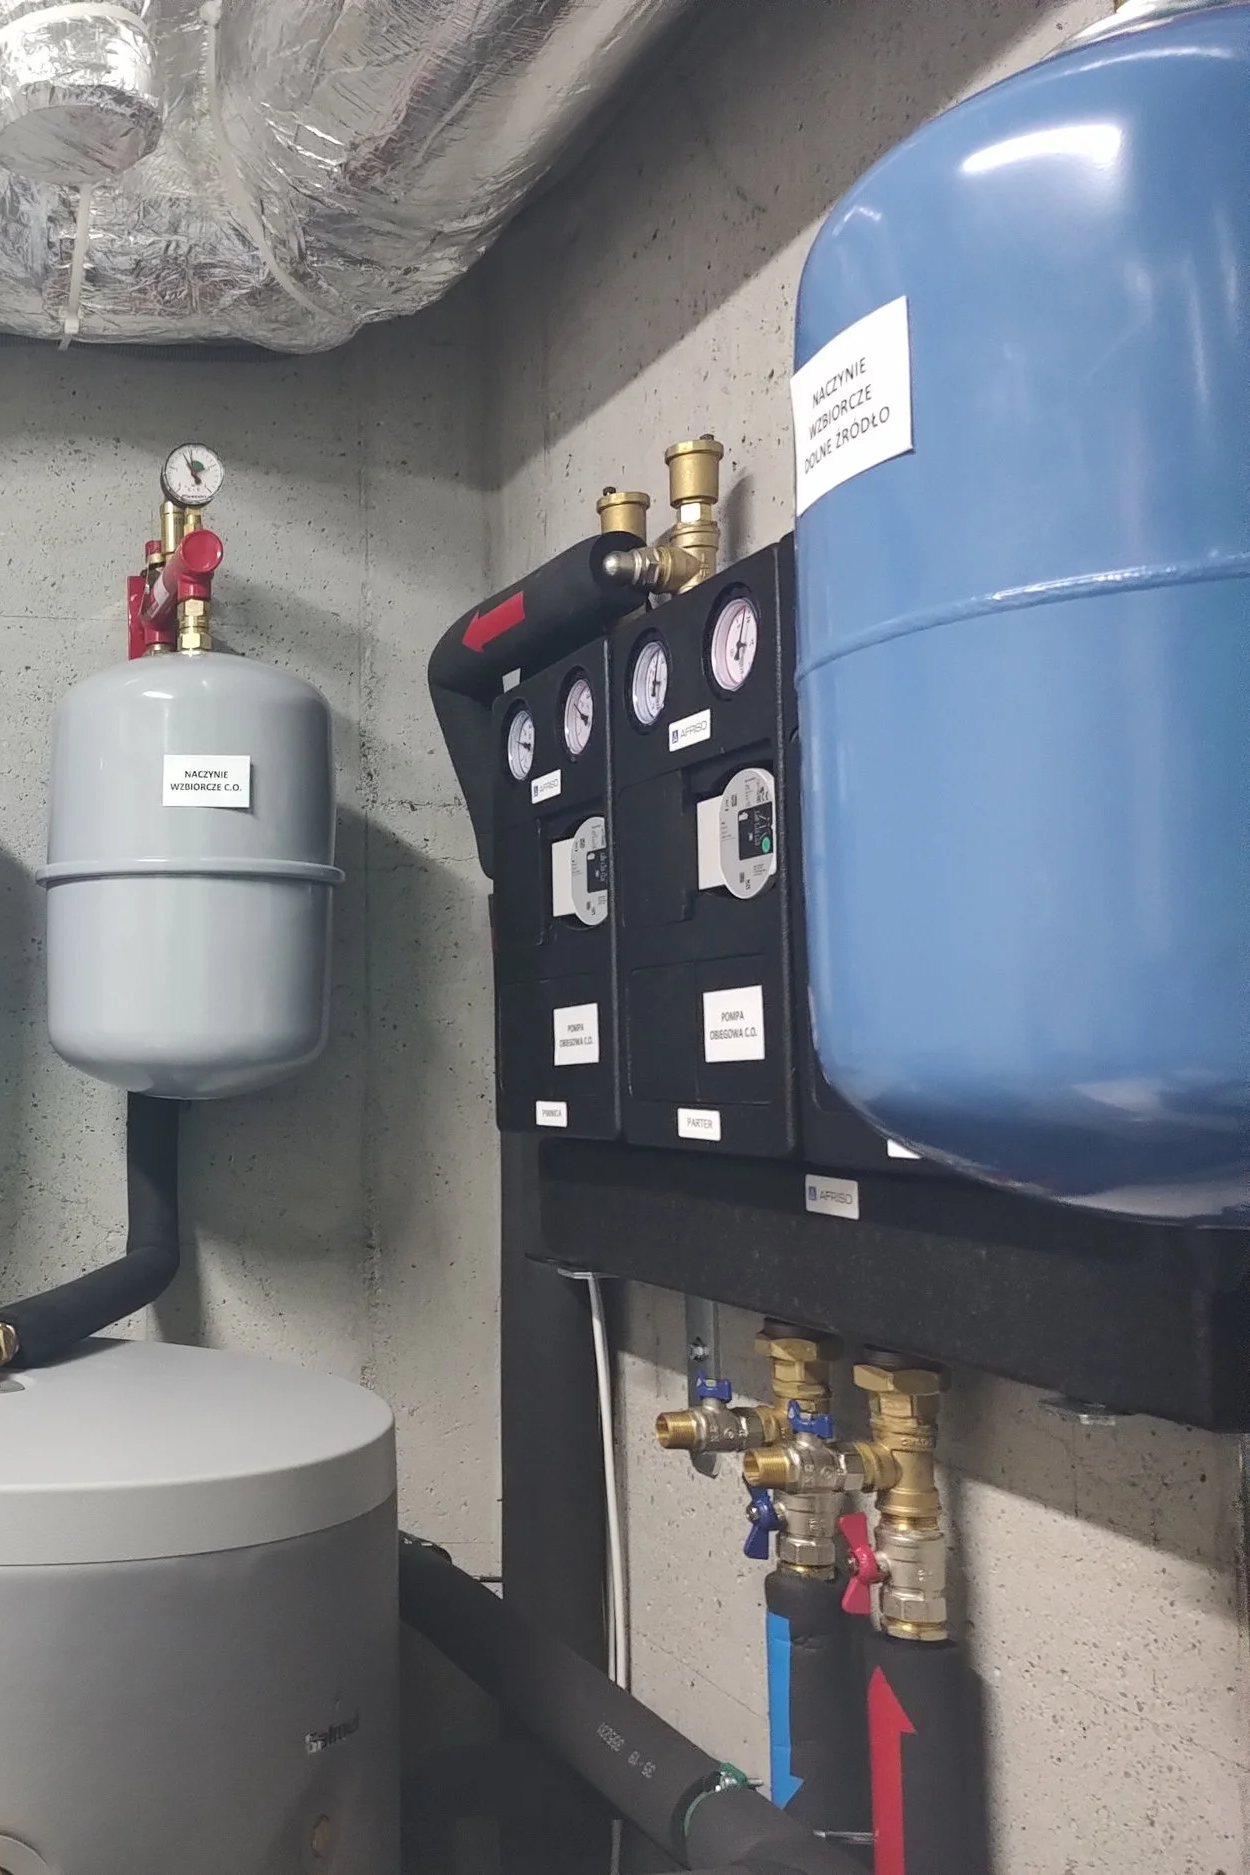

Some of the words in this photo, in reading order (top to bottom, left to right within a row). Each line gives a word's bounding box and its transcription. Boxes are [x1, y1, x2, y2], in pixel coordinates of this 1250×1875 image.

[812, 357, 866, 408] NACZYNIE
[809, 384, 872, 440] WZBIORCZE
[804, 438, 832, 475] DOLNE
[184, 771, 229, 779] NACZYNIE
[170, 783, 222, 791] WZBIORCZE
[224, 784, 243, 792] C.O.
[721, 1010, 744, 1022] POMPA
[709, 1028, 744, 1040] OBIEGOWA
[687, 1117, 713, 1129] PARTER
[819, 1190, 853, 1204] AFRISO
